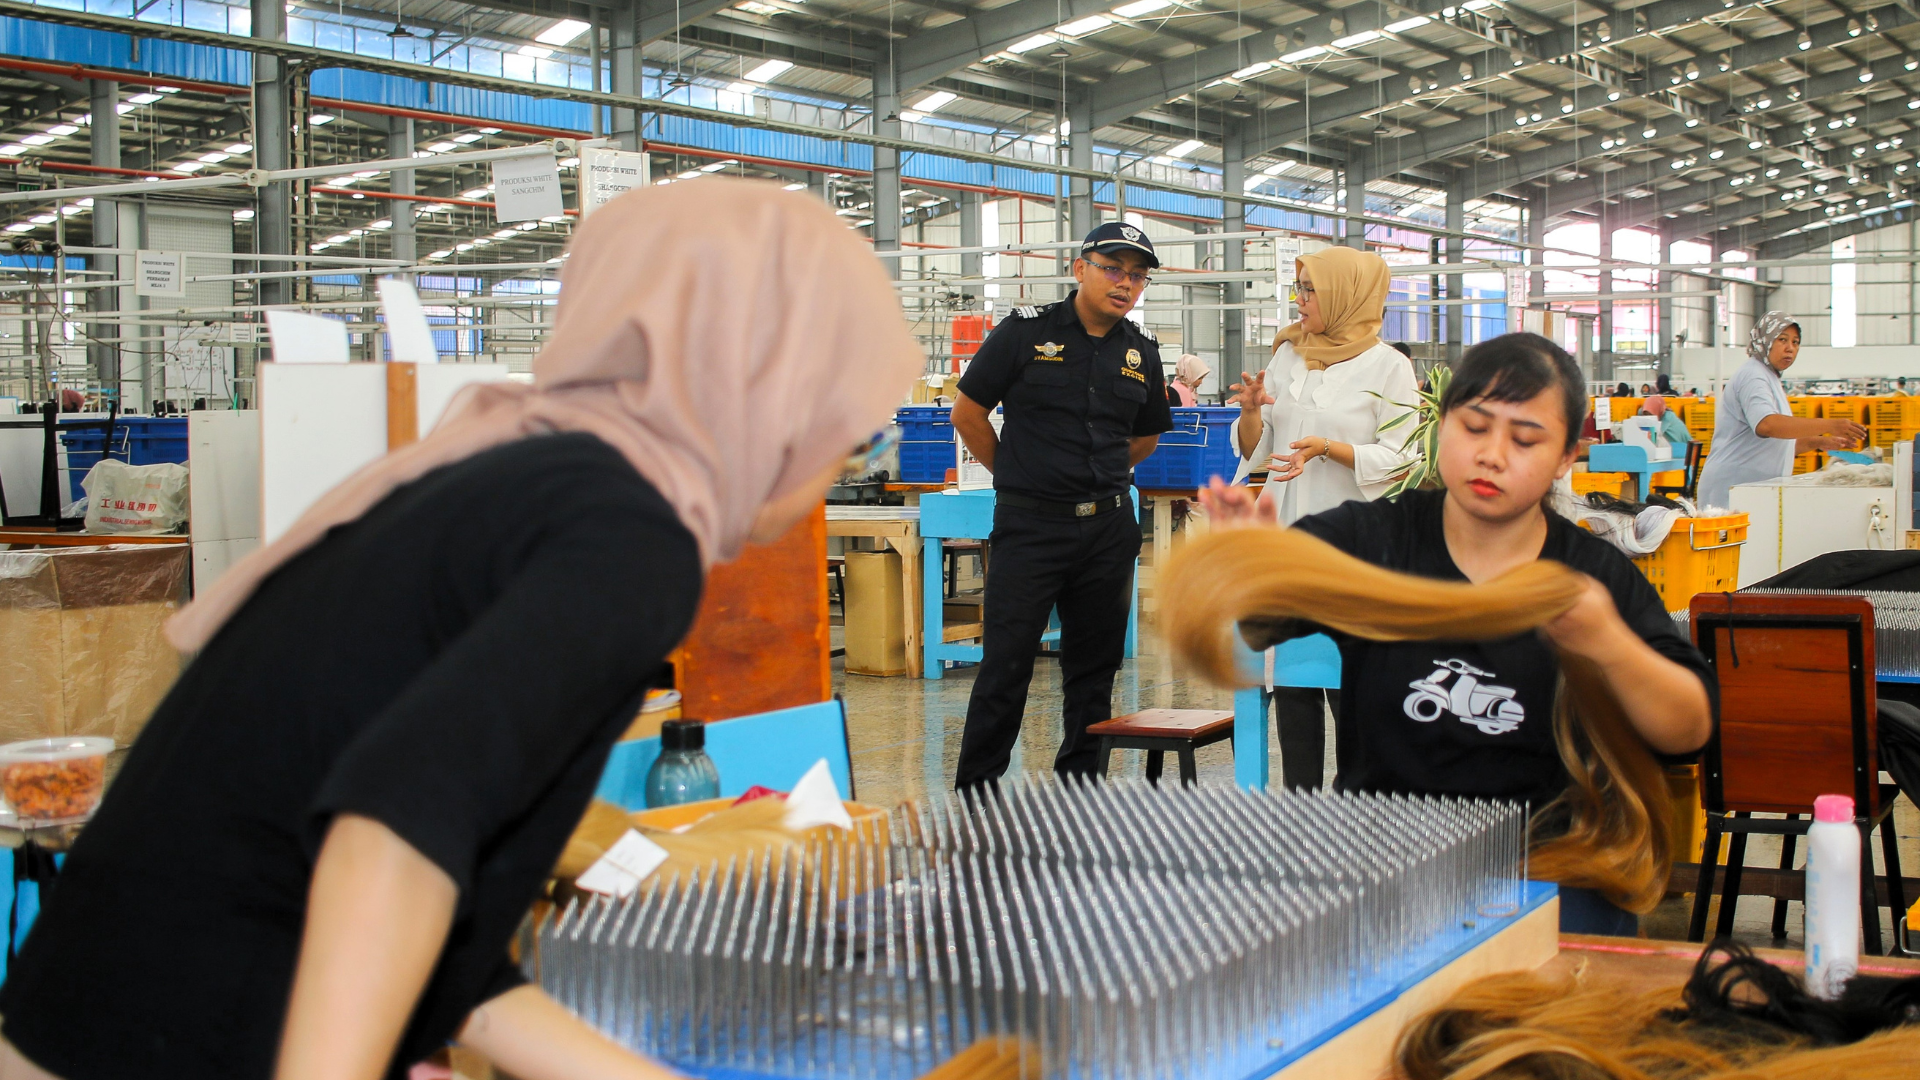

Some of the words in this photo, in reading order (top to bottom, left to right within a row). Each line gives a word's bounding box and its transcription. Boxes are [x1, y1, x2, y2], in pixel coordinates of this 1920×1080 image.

[620, 167, 638, 175] WHITE
[500, 177, 533, 186] PRODUKSI
[533, 174, 553, 183] WHITE
[511, 186, 545, 196] SANGCHIM
